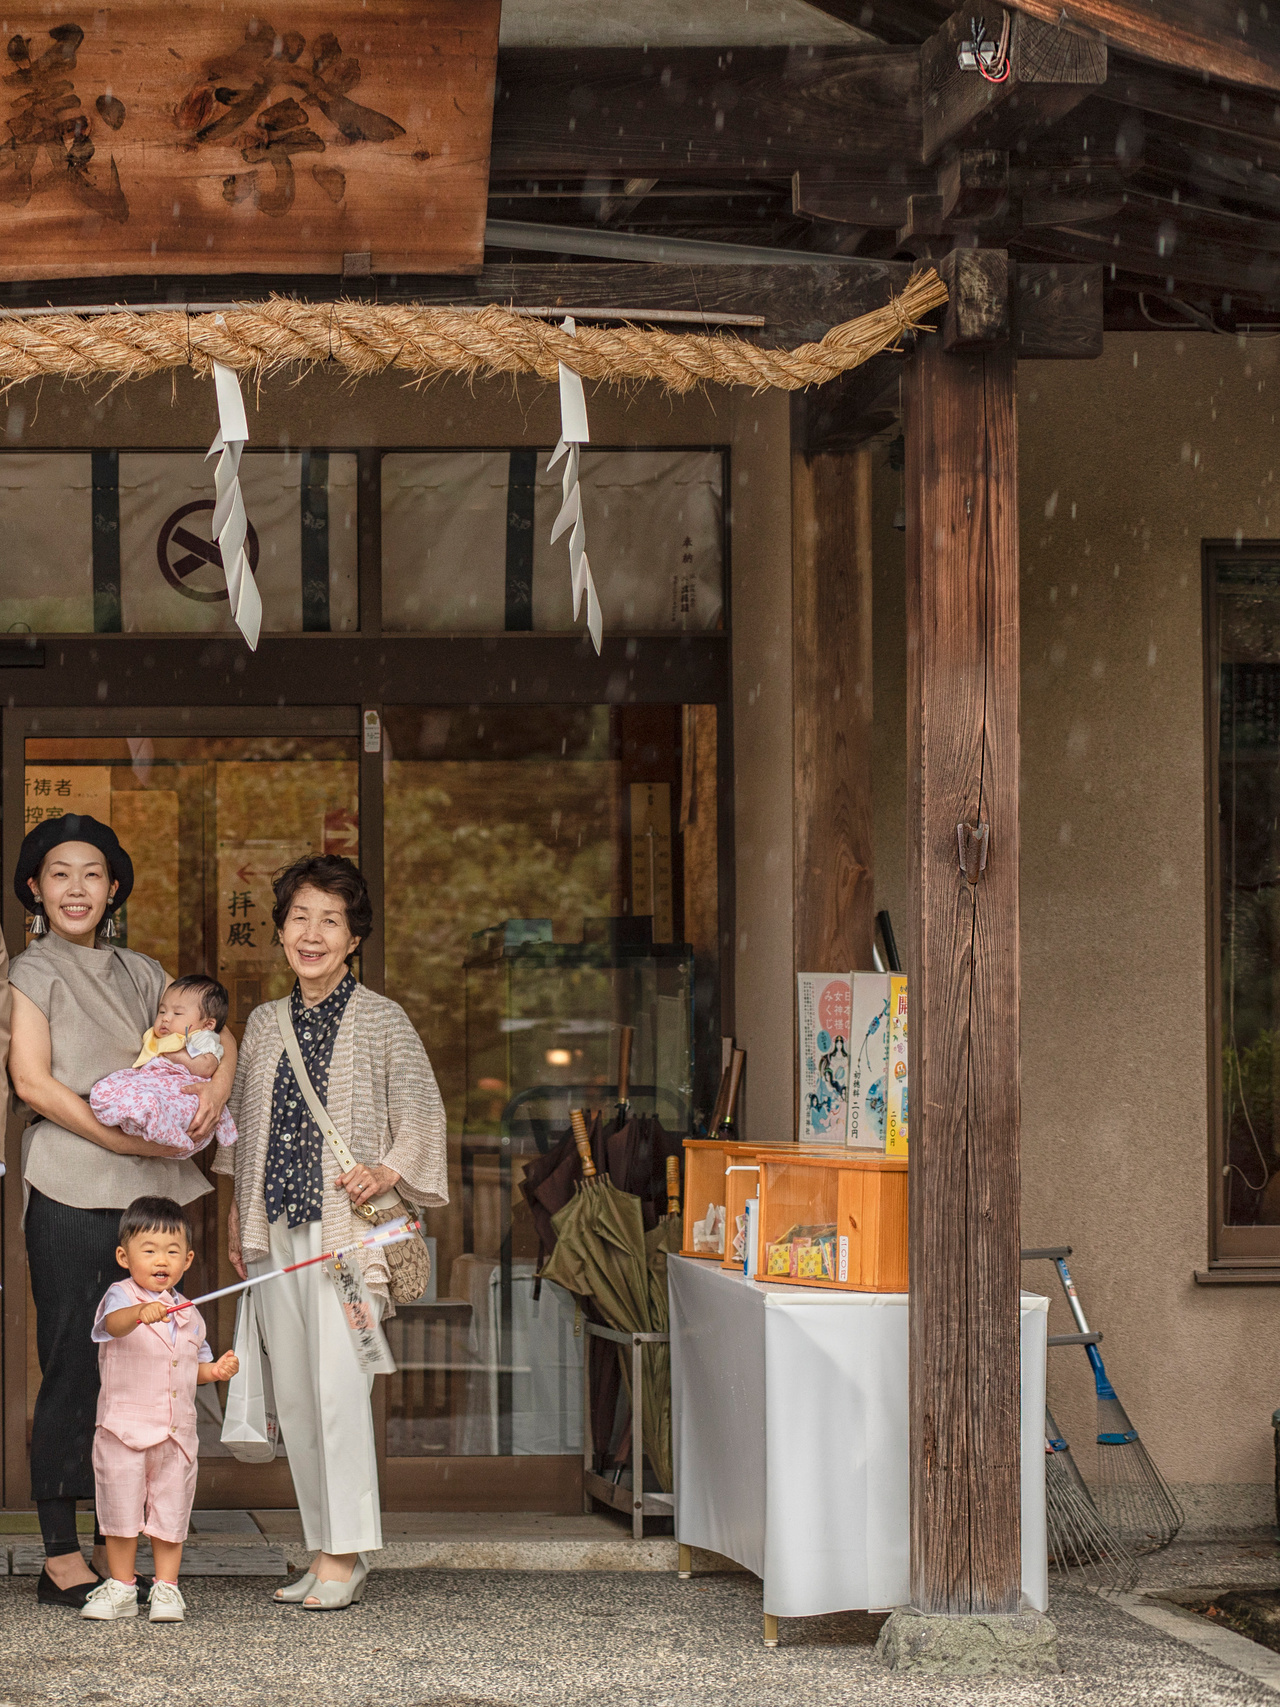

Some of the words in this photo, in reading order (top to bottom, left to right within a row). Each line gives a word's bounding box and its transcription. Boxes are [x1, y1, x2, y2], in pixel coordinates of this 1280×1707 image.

[227, 890, 257, 948] 拝殿
[824, 991, 834, 1030] みくじ
